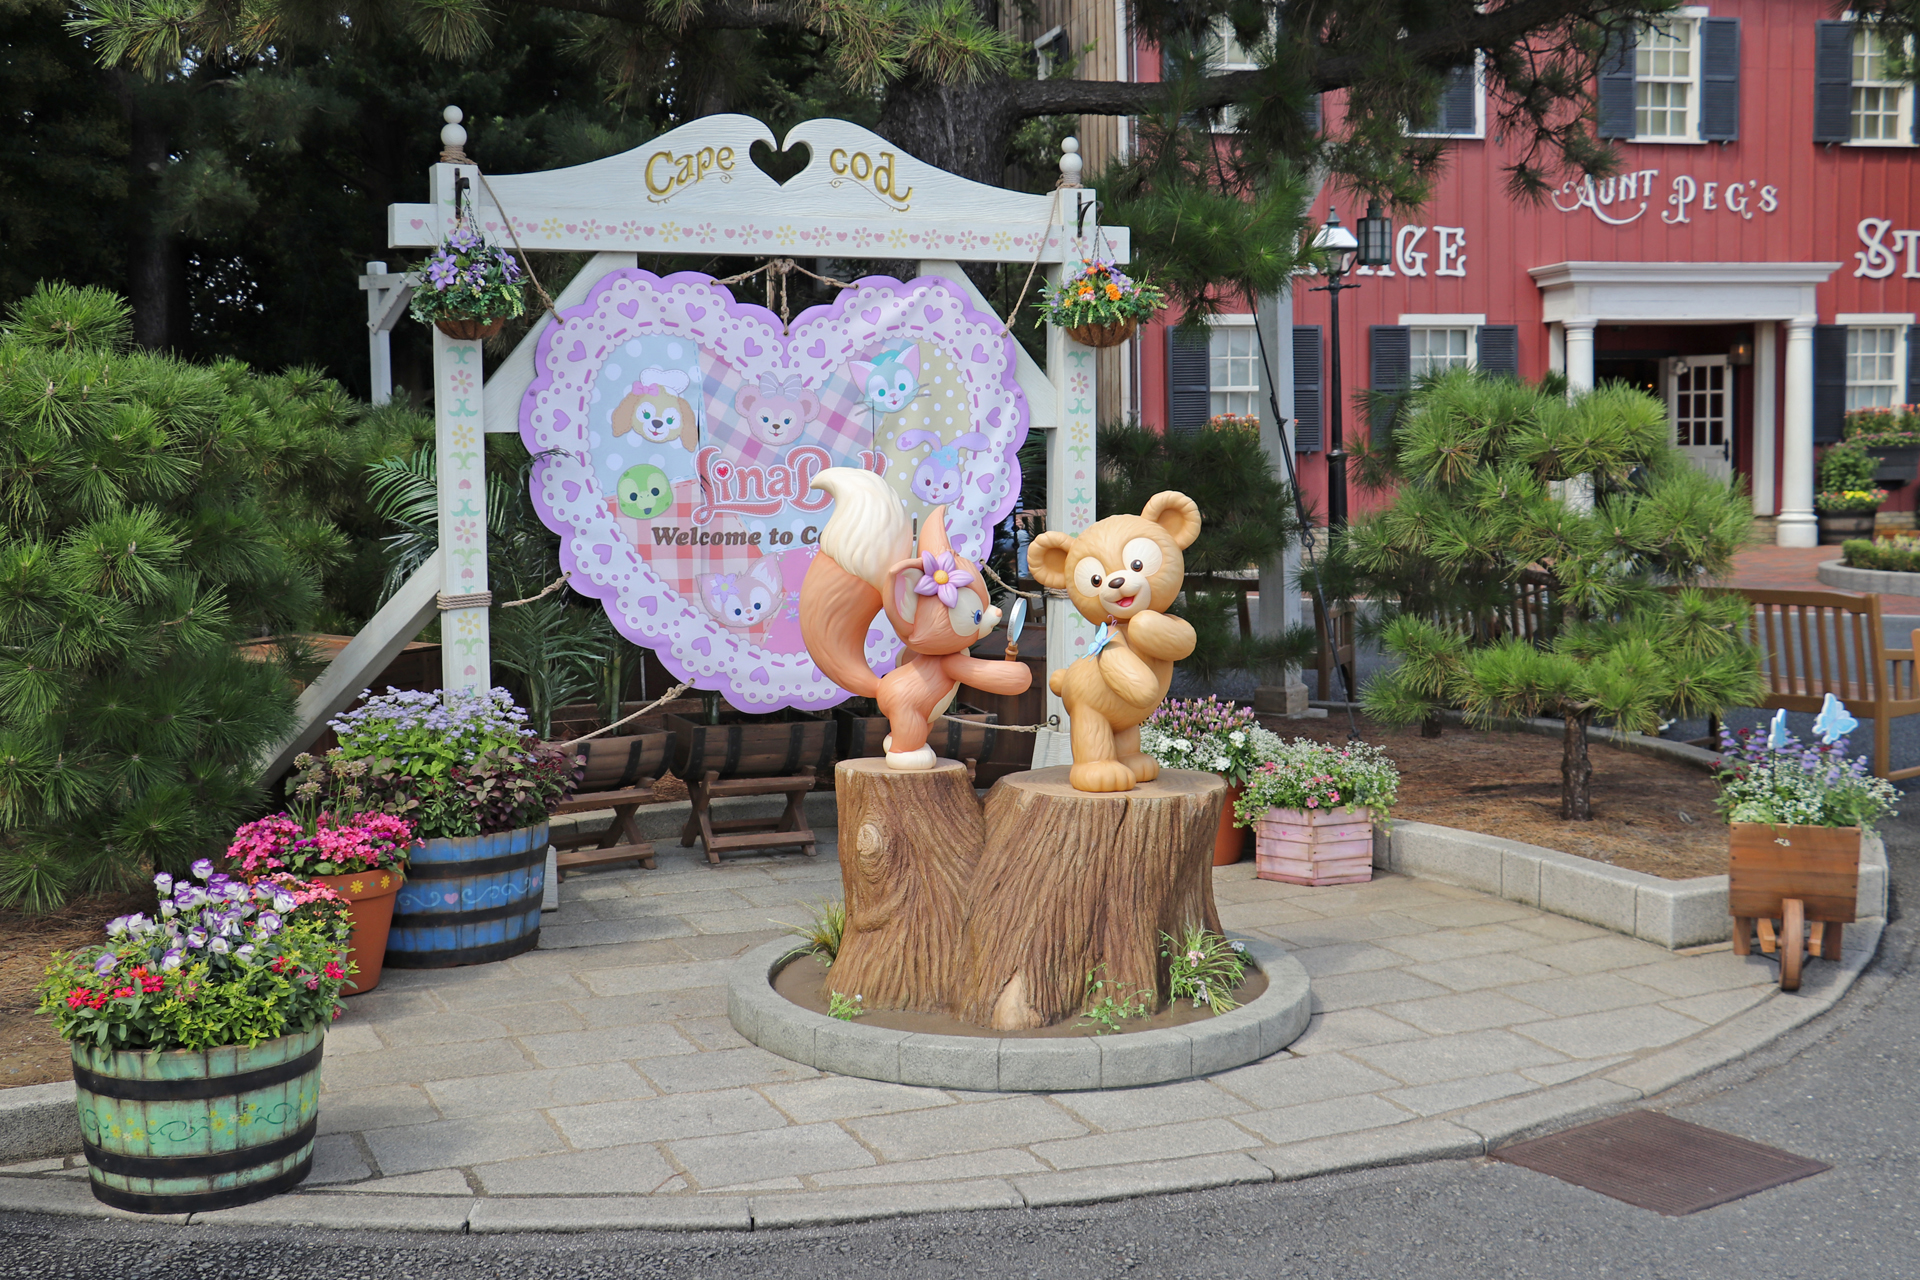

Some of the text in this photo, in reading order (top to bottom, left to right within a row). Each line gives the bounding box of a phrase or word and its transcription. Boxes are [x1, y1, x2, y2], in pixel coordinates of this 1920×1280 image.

[644, 146, 735, 196] Cape
[691, 446, 888, 526] LinaB
[651, 526, 762, 546] Welcome
[769, 528, 793, 545] to
